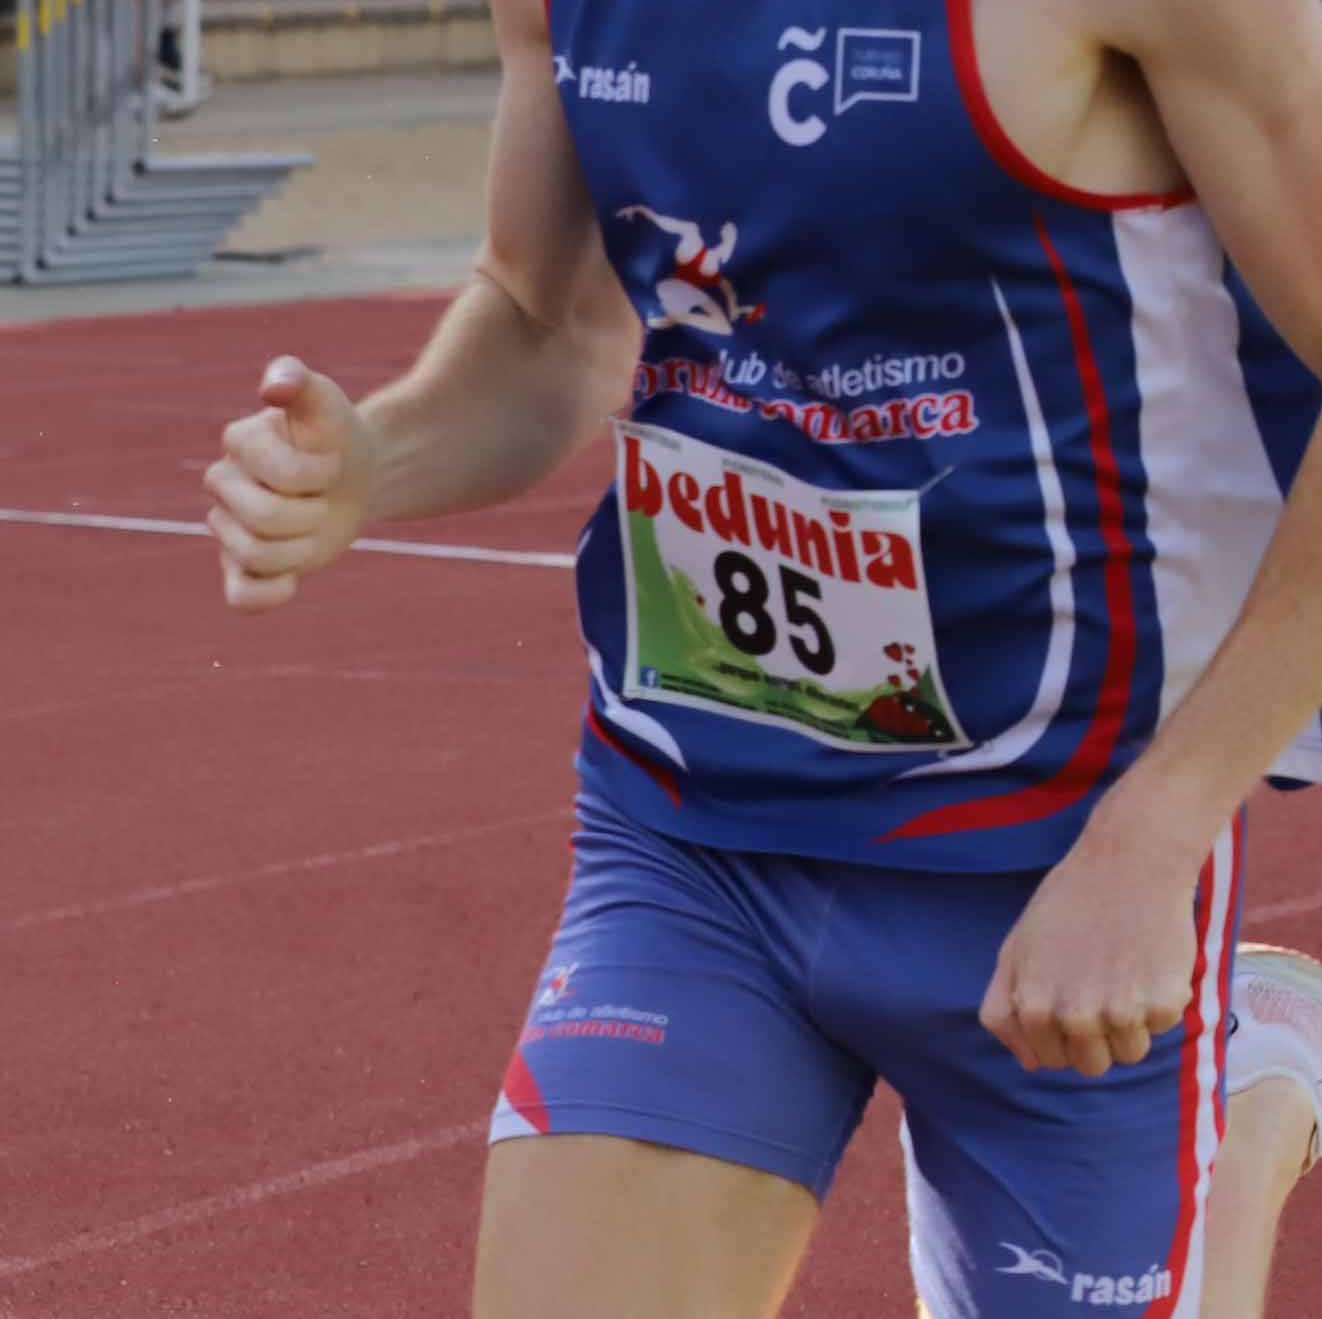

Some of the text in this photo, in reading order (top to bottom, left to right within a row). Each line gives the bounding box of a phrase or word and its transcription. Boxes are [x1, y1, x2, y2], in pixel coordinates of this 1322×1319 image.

[579, 61, 650, 104] rasán
[624, 436, 920, 592] bedunia
[714, 550, 836, 676] 85
[1070, 1261, 1173, 1307] rasán
